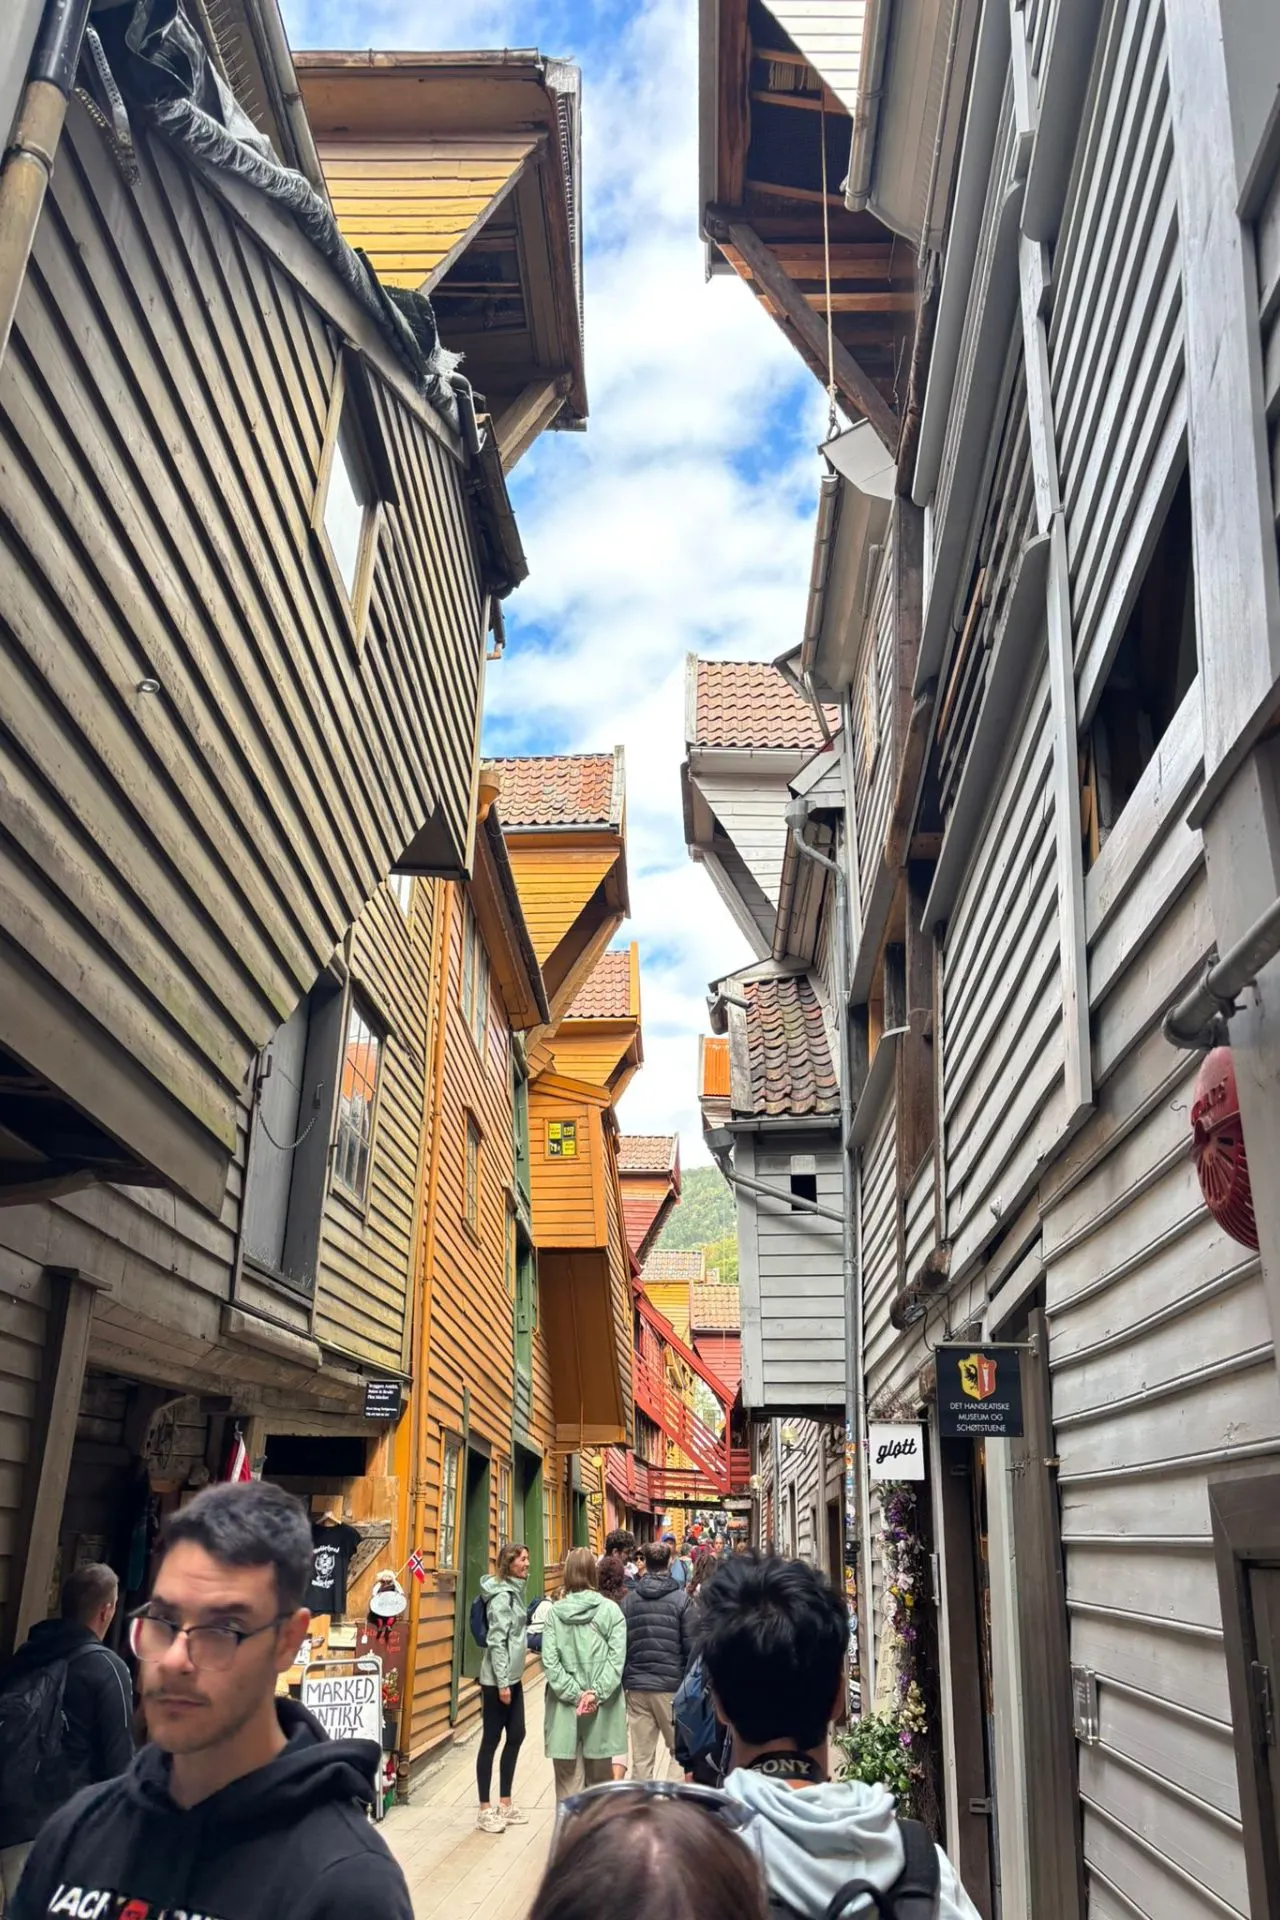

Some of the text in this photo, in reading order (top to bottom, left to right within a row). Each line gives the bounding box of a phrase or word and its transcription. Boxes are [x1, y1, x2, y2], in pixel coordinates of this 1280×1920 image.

[949, 1402, 1010, 1411] DET HANSEATISKE
[958, 1413, 1004, 1421] MUSEUM OG
[956, 1423, 1007, 1433] SCHØTSTUENE
[876, 1438, 917, 1465] gløtt
[306, 1677, 375, 1705] MARKED
